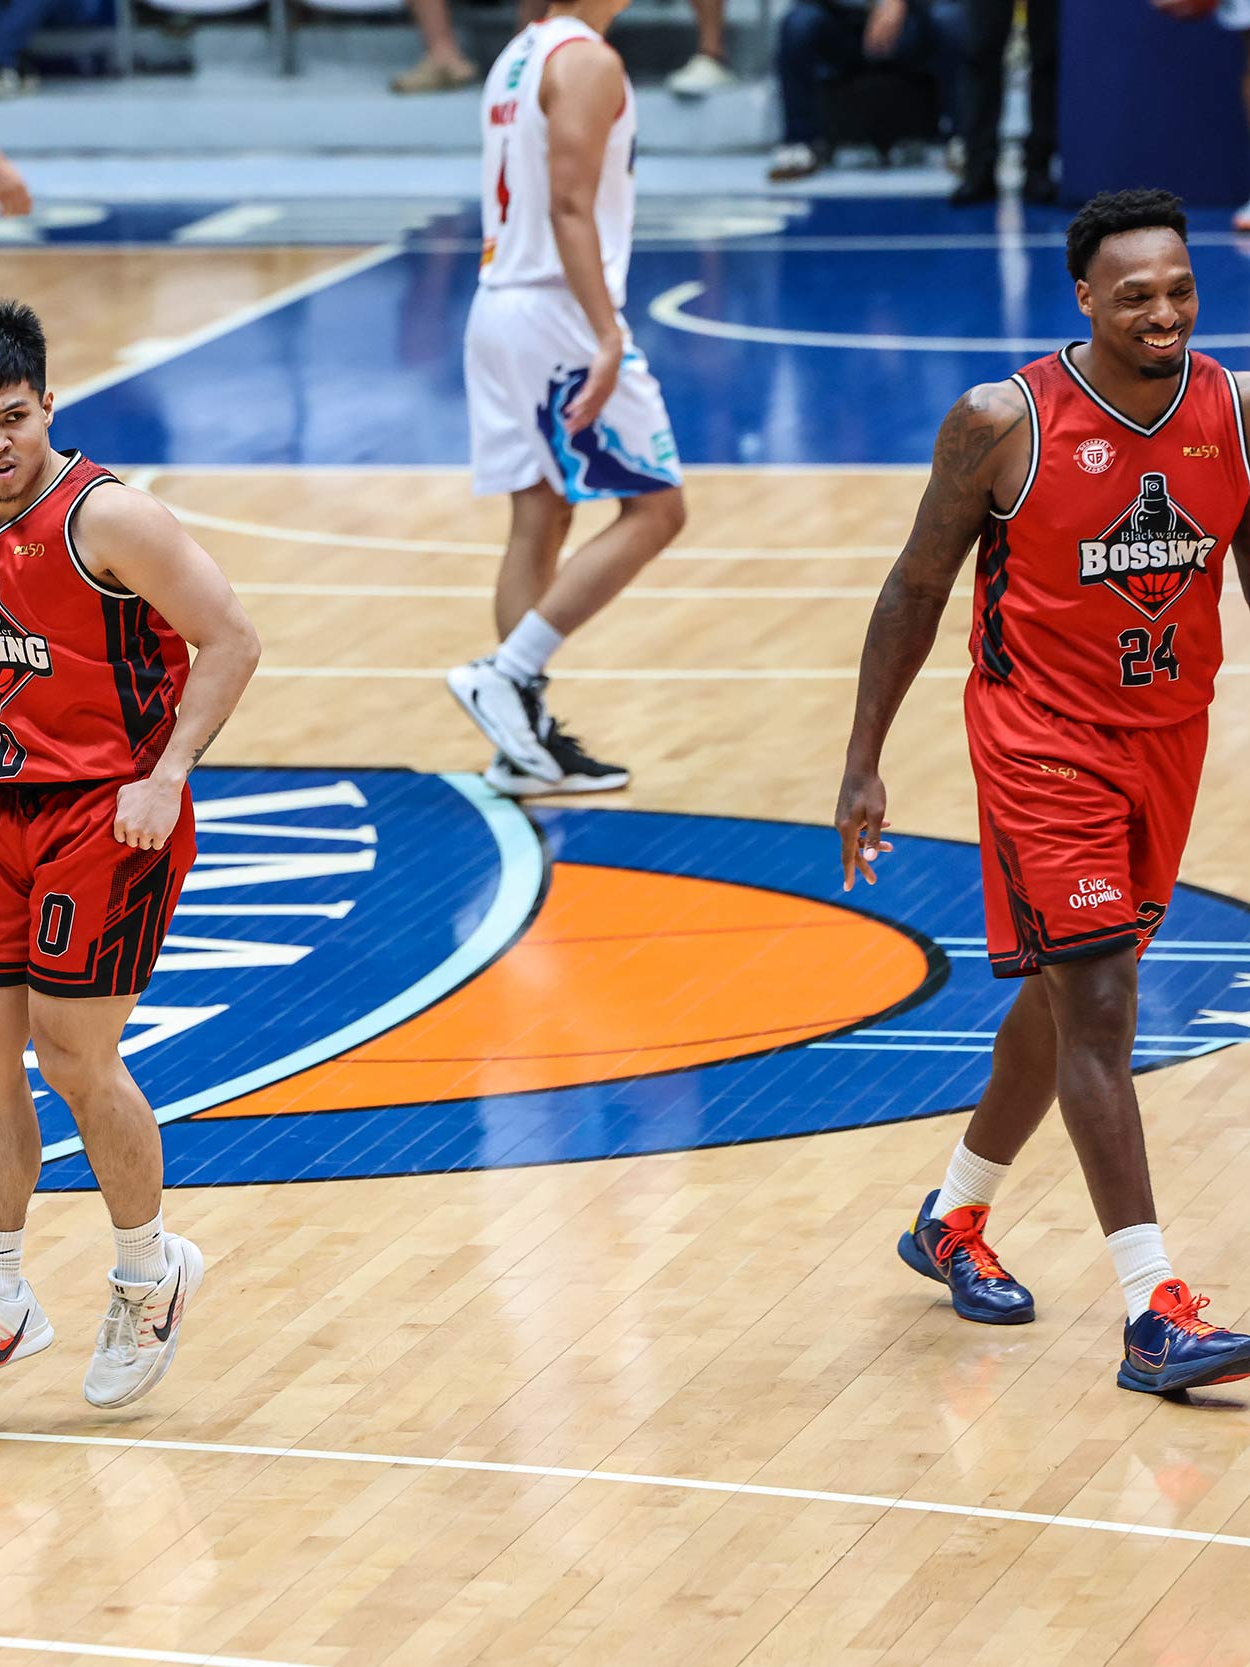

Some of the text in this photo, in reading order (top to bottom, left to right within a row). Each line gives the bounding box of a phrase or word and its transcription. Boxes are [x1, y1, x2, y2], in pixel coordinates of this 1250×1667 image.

[1121, 529, 1191, 542] Blackwater
[1081, 537, 1217, 577] BOSSING
[1118, 623, 1180, 688] 24
[1069, 886, 1123, 909] Organics
[1078, 878, 1108, 894] Ever
[37, 891, 76, 958] 0
